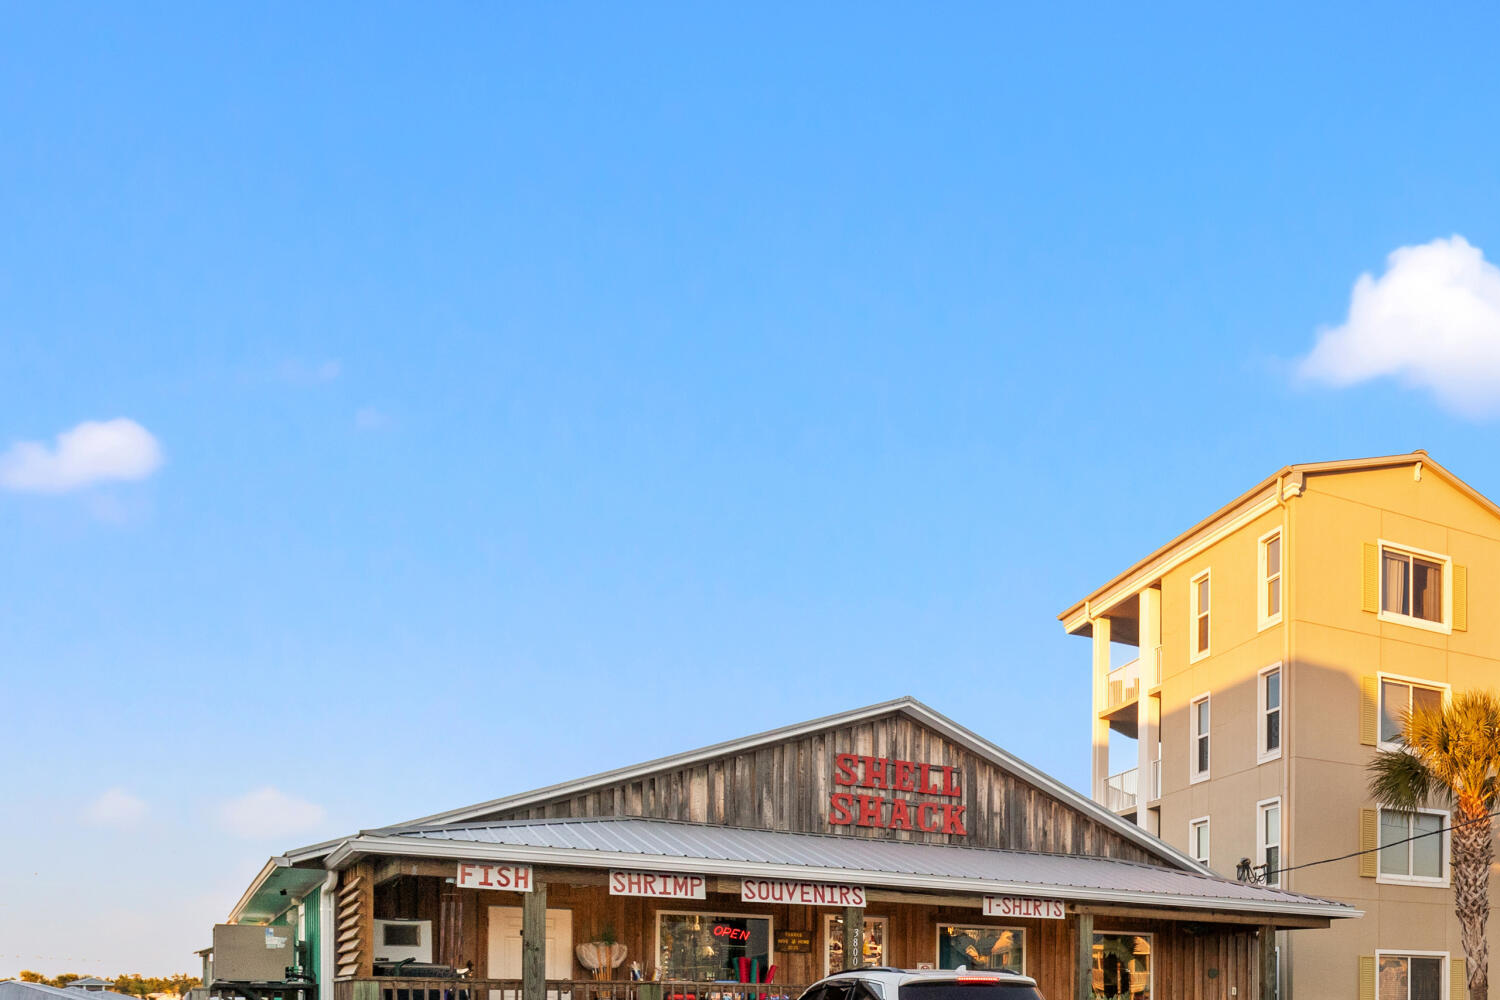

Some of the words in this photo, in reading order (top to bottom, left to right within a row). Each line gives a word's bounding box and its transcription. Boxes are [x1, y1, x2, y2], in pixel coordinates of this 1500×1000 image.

[835, 753, 960, 797] SHELL
[829, 793, 967, 836] SHACK
[460, 864, 529, 889] FISH
[613, 872, 703, 896] SHRIMP
[744, 880, 863, 905] SOUVENIRS
[985, 896, 1062, 917] T-SHIRTS
[713, 925, 751, 941] OPEN
[852, 928, 860, 966] 3800
